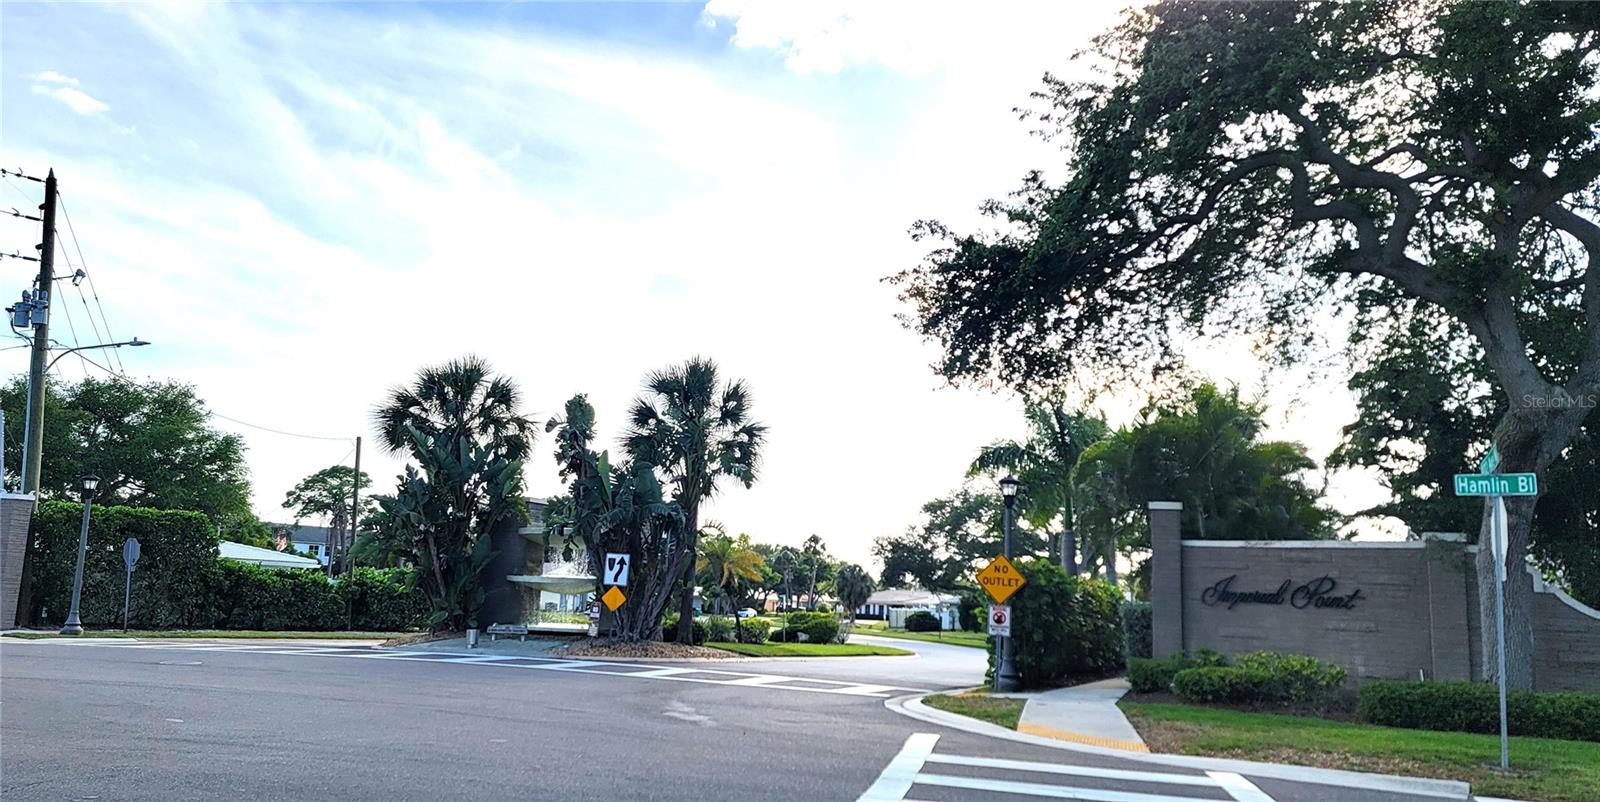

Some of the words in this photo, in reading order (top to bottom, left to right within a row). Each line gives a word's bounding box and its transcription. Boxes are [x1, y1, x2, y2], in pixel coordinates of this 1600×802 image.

[1458, 477, 1509, 493] Hamlin
[1518, 476, 1533, 492] Bl
[994, 565, 1008, 574] NO
[983, 577, 1019, 587] OUTLET
[1202, 575, 1290, 609] Imperial
[1291, 575, 1365, 609] Point
